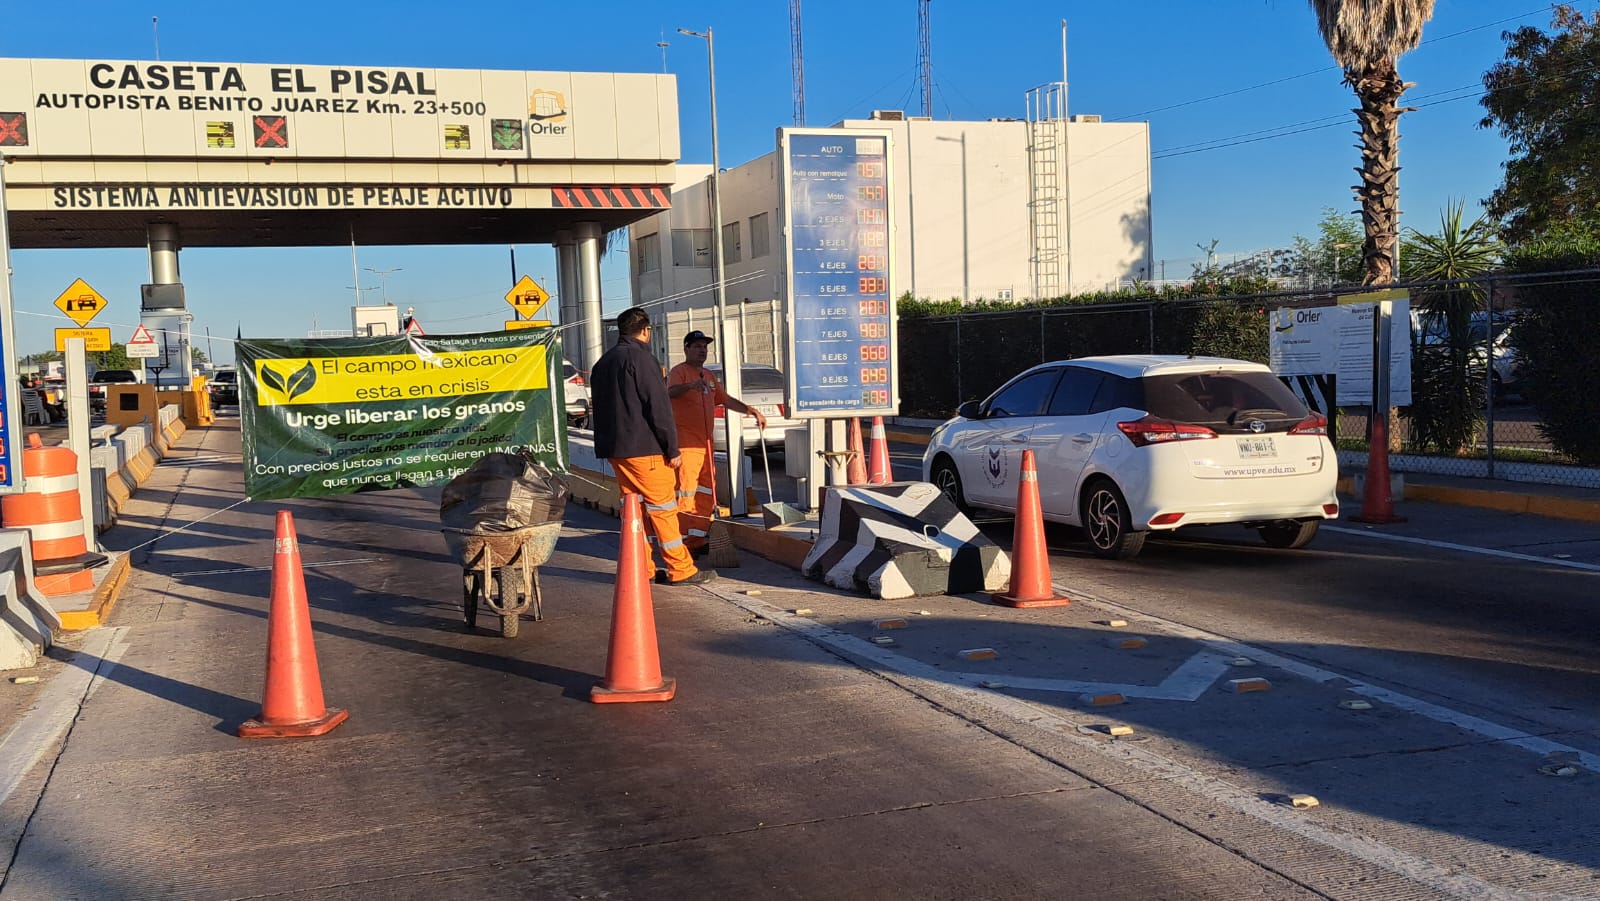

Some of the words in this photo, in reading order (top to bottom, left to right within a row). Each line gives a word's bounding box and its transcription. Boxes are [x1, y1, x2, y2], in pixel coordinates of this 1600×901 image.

[90, 63, 246, 92] CASETA
[270, 68, 317, 93] EL
[331, 69, 436, 95] PISAL
[36, 93, 170, 111] AUTOPISTA
[178, 96, 263, 112] BENITO
[270, 98, 359, 114] JUAREZ
[366, 100, 406, 115] Km.
[413, 100, 486, 116] 23+500
[530, 122, 567, 135] Orler
[54, 186, 160, 208] SISTEMA
[168, 185, 318, 207] ANTIEVASION
[327, 186, 354, 207] DE
[362, 186, 433, 207] PEAJE
[437, 186, 513, 206] ACTIVO
[826, 262, 847, 270] EJES
[820, 285, 825, 293] 5
[826, 285, 847, 293] EJES
[820, 308, 826, 316] 6
[827, 308, 847, 316] EJES
[1296, 310, 1320, 323] Orler
[479, 336, 508, 344] Anexos
[321, 359, 338, 374] El
[345, 359, 417, 376] campo
[423, 352, 518, 370] mexicano
[828, 353, 848, 361] EJES
[355, 384, 402, 399] esta
[408, 383, 433, 396] en
[439, 377, 490, 394] crisis
[286, 411, 341, 430] Urge
[345, 408, 418, 425] liberar
[422, 405, 452, 420] los
[455, 400, 526, 420] granos
[255, 464, 284, 475] Con
[288, 459, 340, 475] precios
[342, 457, 383, 471] justos
[385, 456, 402, 465] no
[406, 454, 421, 464] se
[424, 449, 486, 464] requieren
[322, 478, 348, 488] que
[351, 474, 391, 486] nunca
[395, 469, 432, 482] llegan
[435, 469, 444, 477] a
[1224, 465, 1297, 477] www.upve.edu.mx
